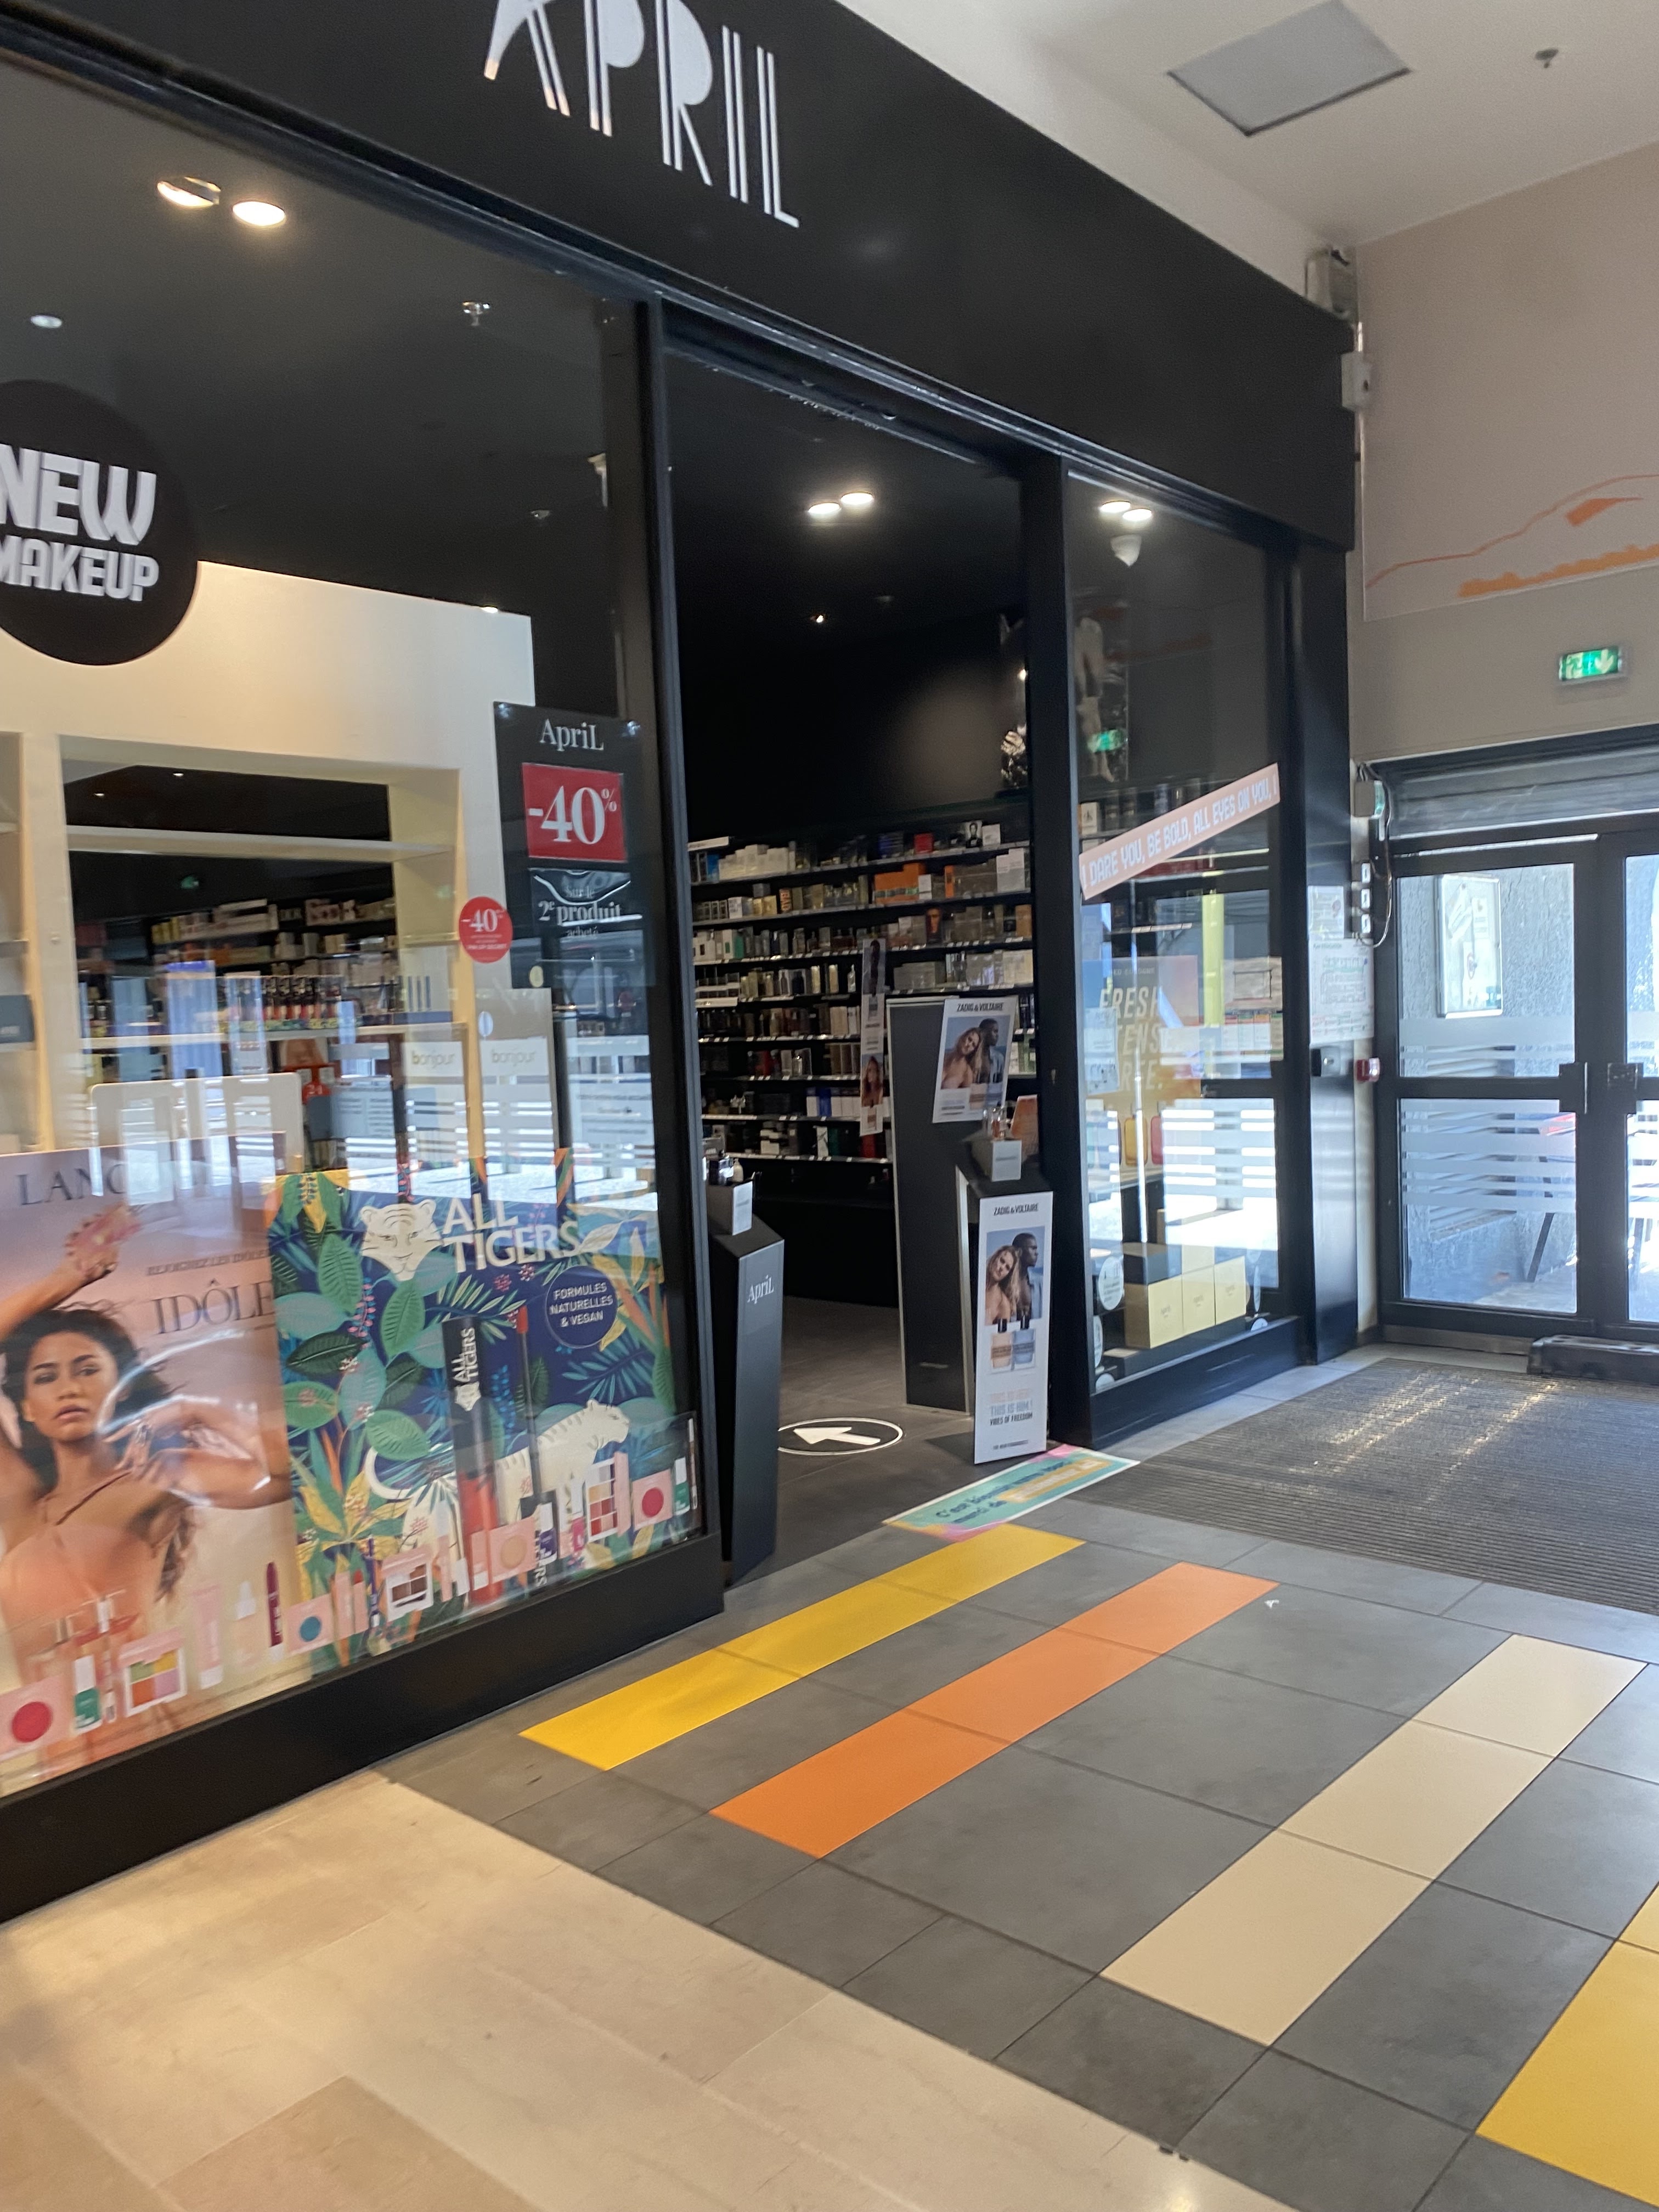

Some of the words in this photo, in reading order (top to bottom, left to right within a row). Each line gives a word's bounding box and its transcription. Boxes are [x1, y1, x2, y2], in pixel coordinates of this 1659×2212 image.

[484, 0, 800, 228] APRIL
[0, 443, 156, 545] NEW
[0, 534, 159, 602] MAKEUP
[528, 785, 617, 845] -40%
[1090, 850, 1119, 886] DARE
[1121, 838, 1146, 870] YOU,
[1147, 830, 1161, 857] BE
[1163, 817, 1192, 849] BOLD,
[1193, 806, 1211, 835] ALL
[1212, 794, 1235, 826] EYES
[1238, 788, 1250, 812] ON
[557, 901, 621, 927] produit
[979, 1002, 1004, 1011] VOLTAIRE
[443, 1193, 518, 1234] ALL
[441, 1220, 581, 1273] TIGERS
[150, 1278, 275, 1335] IDÔLE
[550, 1295, 613, 1315] NATURELLES
[553, 1282, 608, 1300] FORMULES
[560, 1316, 569, 1328] &
[571, 1310, 604, 1325] VEGAN
[461, 1327, 479, 1378] TIGERS
